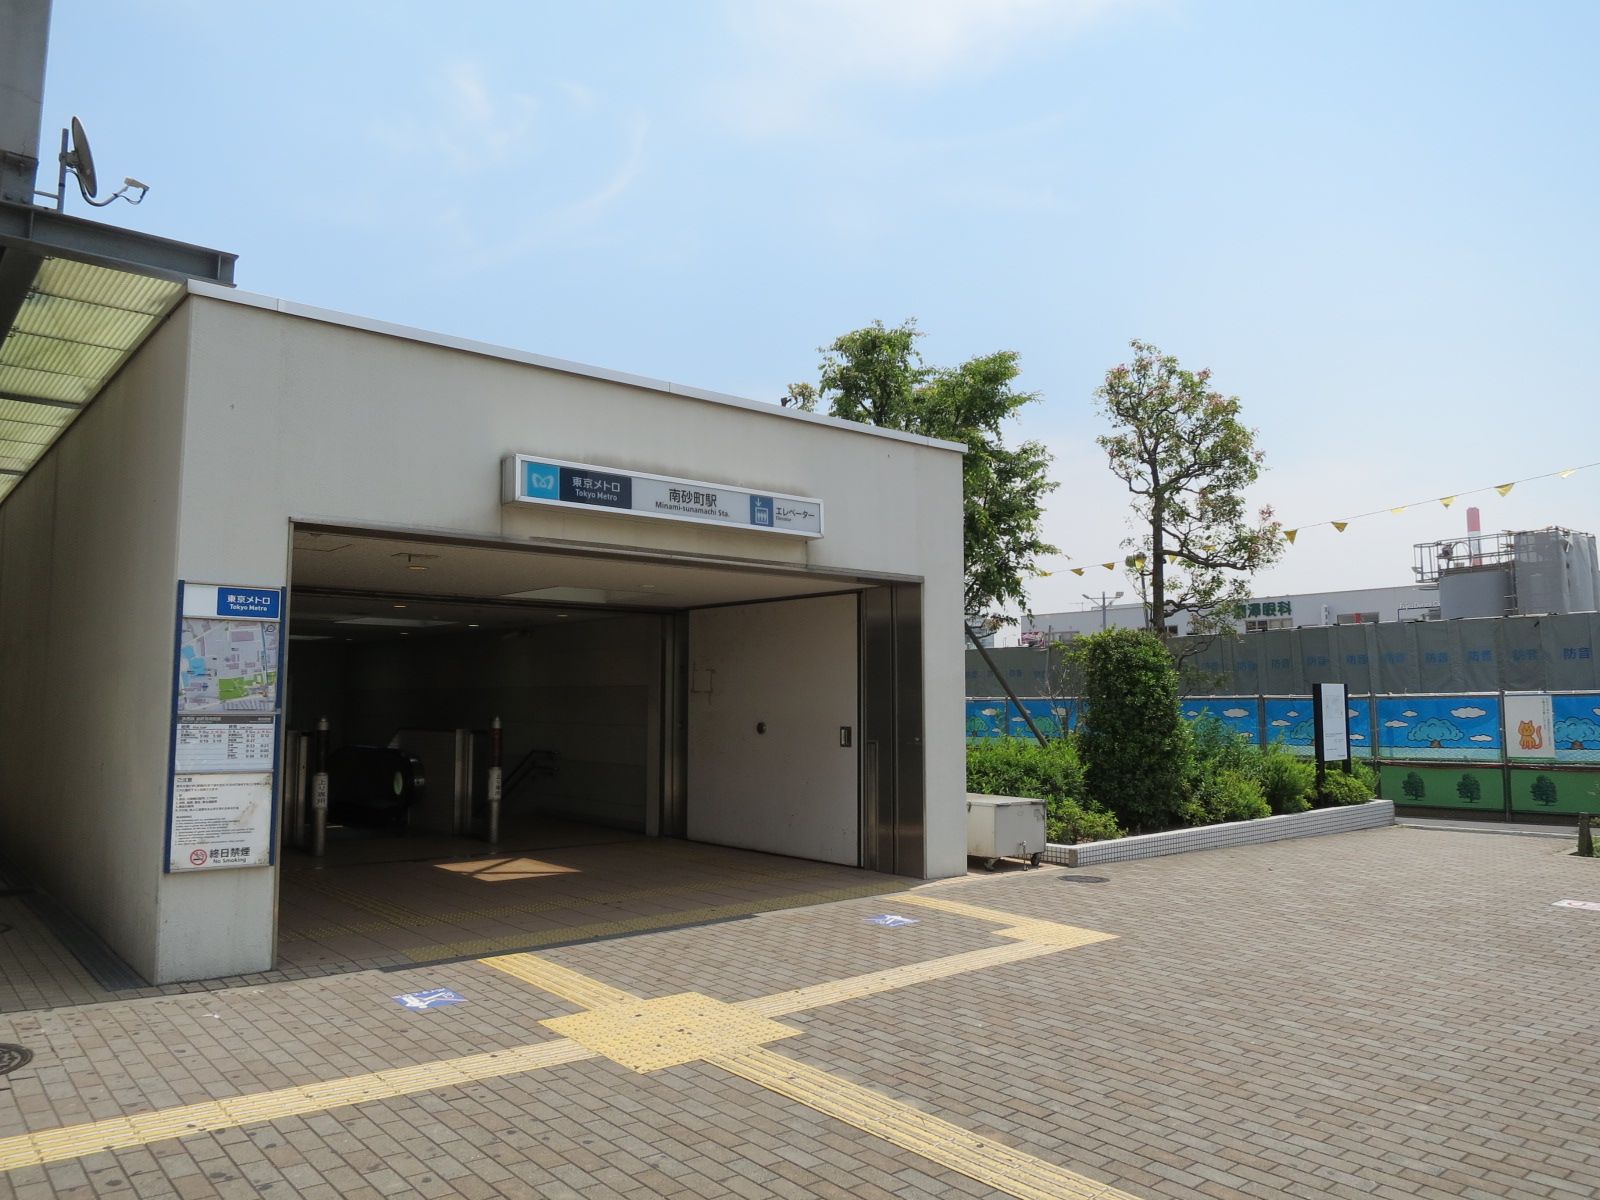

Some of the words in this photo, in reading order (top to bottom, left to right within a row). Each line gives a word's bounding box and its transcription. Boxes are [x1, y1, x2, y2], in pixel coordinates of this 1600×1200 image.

[572, 477, 620, 492] 東京メトロ
[575, 488, 595, 499] Tokyo
[597, 491, 617, 501] Metro
[669, 488, 717, 507] 南砂町駅
[655, 501, 717, 515] Minami-sunamachi
[718, 509, 730, 517] Sta.
[776, 507, 815, 518] エレベーター
[227, 594, 270, 605] 東京メトロ
[230, 603, 248, 611] Tokyo
[210, 847, 250, 859] 終日禁煙
